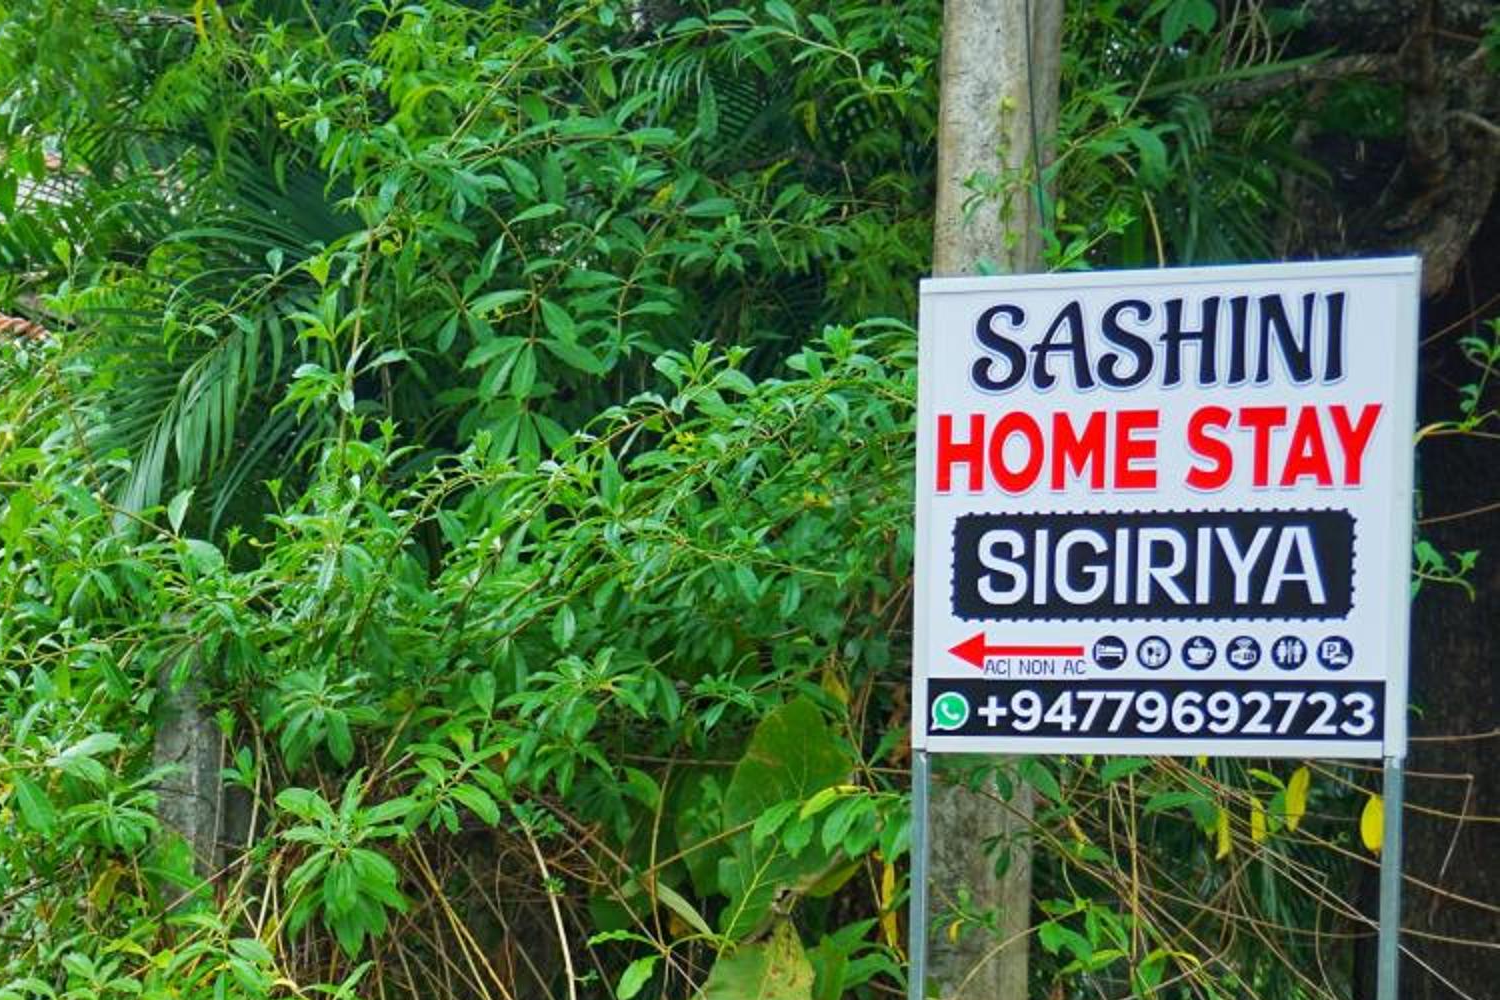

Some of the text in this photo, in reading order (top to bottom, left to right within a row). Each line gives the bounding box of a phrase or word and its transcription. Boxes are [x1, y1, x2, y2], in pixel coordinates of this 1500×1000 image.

[972, 291, 1346, 391] SASHINI
[934, 403, 1383, 493] HOME STAY
[976, 526, 1327, 606] SIGIRIYA
[1019, 659, 1055, 675] NON
[1063, 659, 1087, 675] AC
[977, 690, 1376, 735] +94779692723
